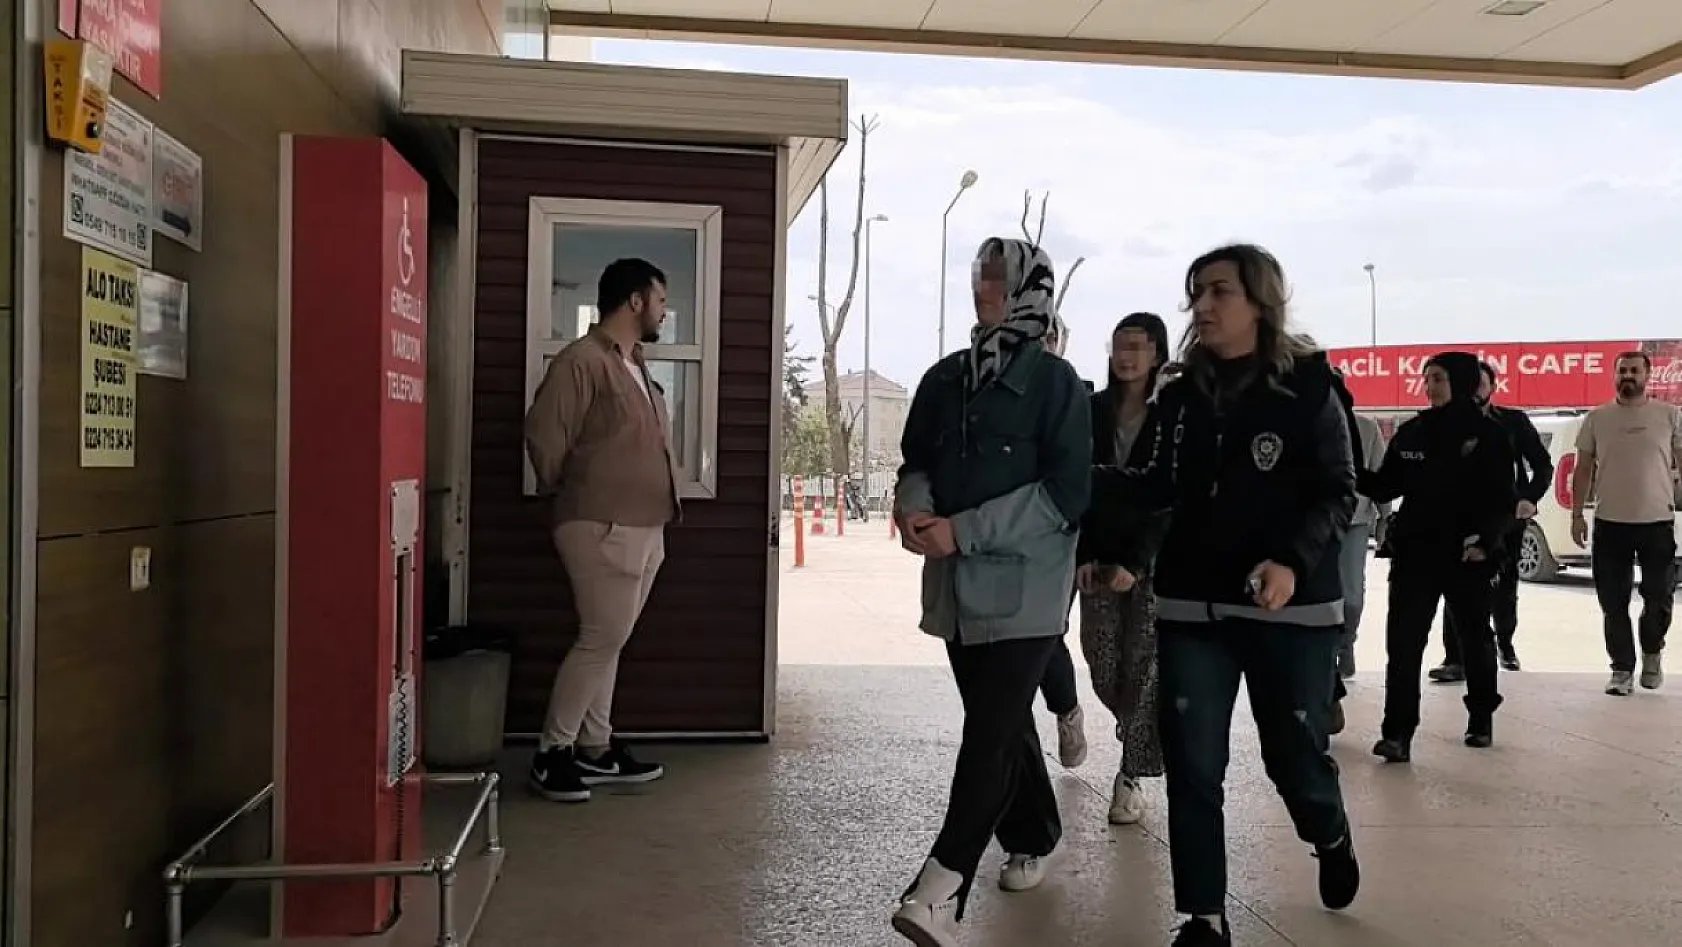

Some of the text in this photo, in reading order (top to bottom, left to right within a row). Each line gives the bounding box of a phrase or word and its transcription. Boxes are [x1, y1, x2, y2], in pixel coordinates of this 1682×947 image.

[86, 267, 106, 300] ALO
[89, 319, 131, 352] HASTANE
[1338, 351, 1390, 377] ACİL
[1517, 352, 1604, 376] CAFE
[85, 427, 101, 450] 0224
